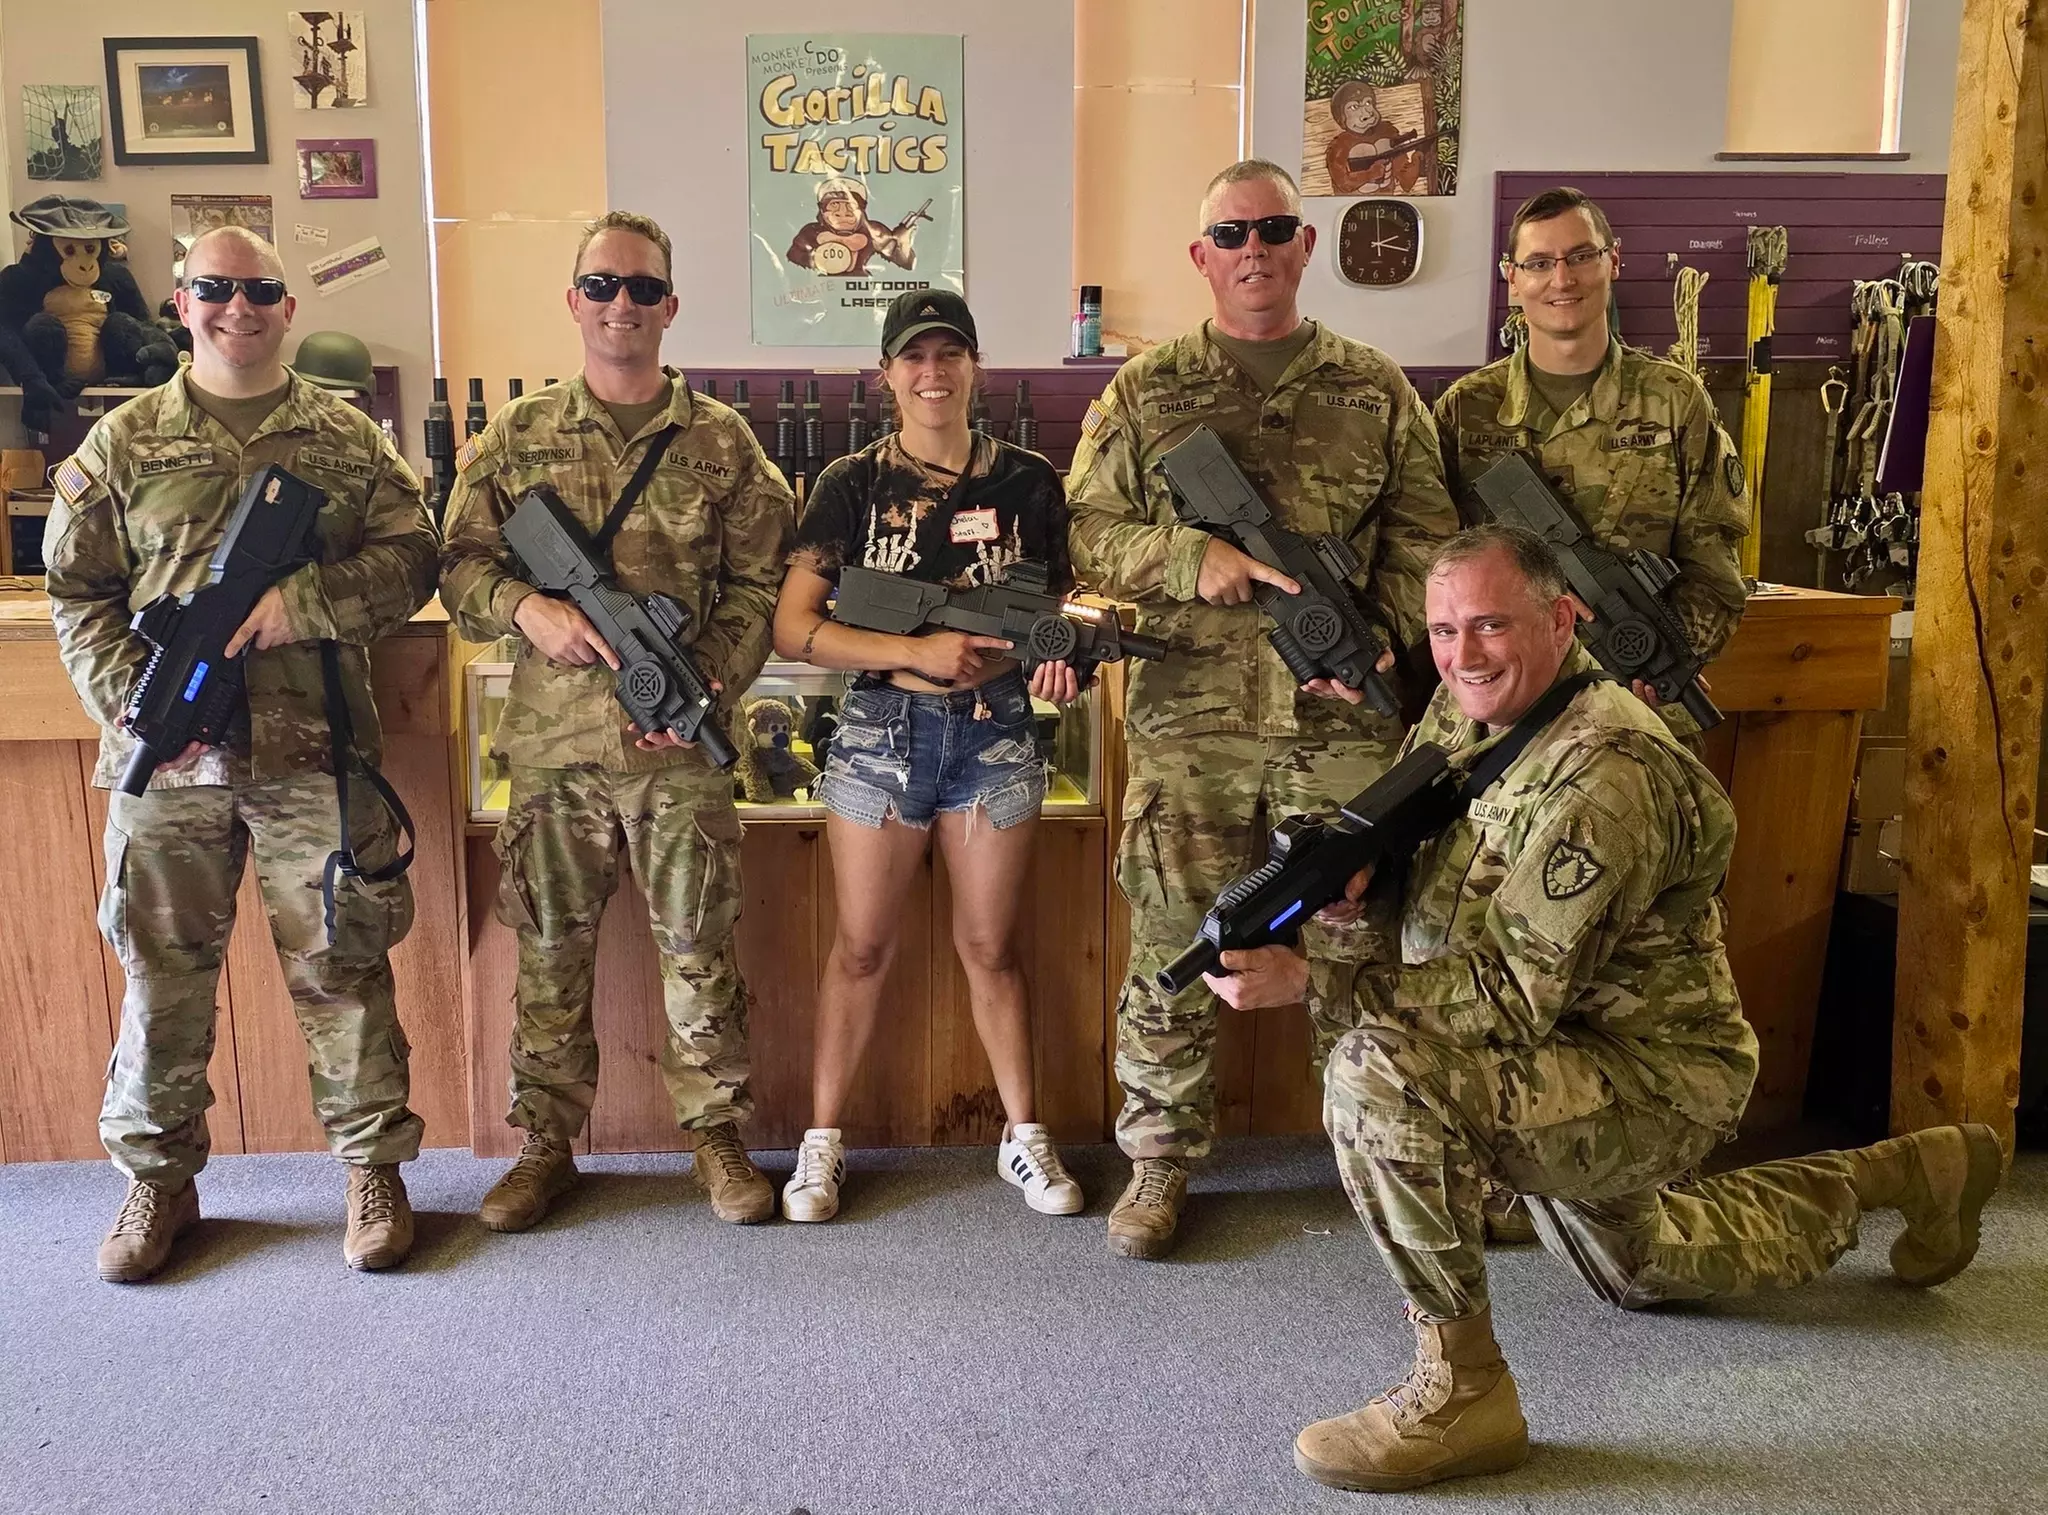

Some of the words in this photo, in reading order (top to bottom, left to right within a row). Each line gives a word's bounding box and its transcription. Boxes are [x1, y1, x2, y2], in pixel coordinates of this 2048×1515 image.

[752, 46, 800, 64] MONKEY
[804, 40, 814, 54] C
[763, 57, 811, 75] MONKEY
[816, 49, 839, 65] DO
[805, 62, 848, 77] Presents
[1360, 210, 1368, 220] 11
[1393, 210, 1398, 220] 1
[1347, 222, 1357, 232] 10
[1404, 222, 1410, 232] 2
[1344, 239, 1351, 249] 9
[1405, 240, 1412, 250] 3
[1850, 233, 1889, 247] Trolleys
[823, 248, 844, 259] CDO
[1346, 256, 1353, 266] 8
[1401, 256, 1407, 266] 4
[1358, 268, 1365, 277] 7
[1372, 270, 1379, 279] 6
[1389, 267, 1396, 277] 5
[773, 280, 835, 307] ULTIMATE
[1159, 398, 1198, 414] CHABE
[1348, 398, 1382, 415] ARMY
[1467, 433, 1520, 447] LAPLANTE
[1630, 433, 1657, 447] ARMY
[518, 447, 575, 463] SERDYNSKI
[140, 453, 203, 473] BENNETT
[308, 453, 331, 468] U.S.
[333, 459, 365, 476] ARMY
[670, 452, 690, 468] U.S.
[693, 460, 730, 478] ARMY
[1487, 805, 1511, 822] ARMY
